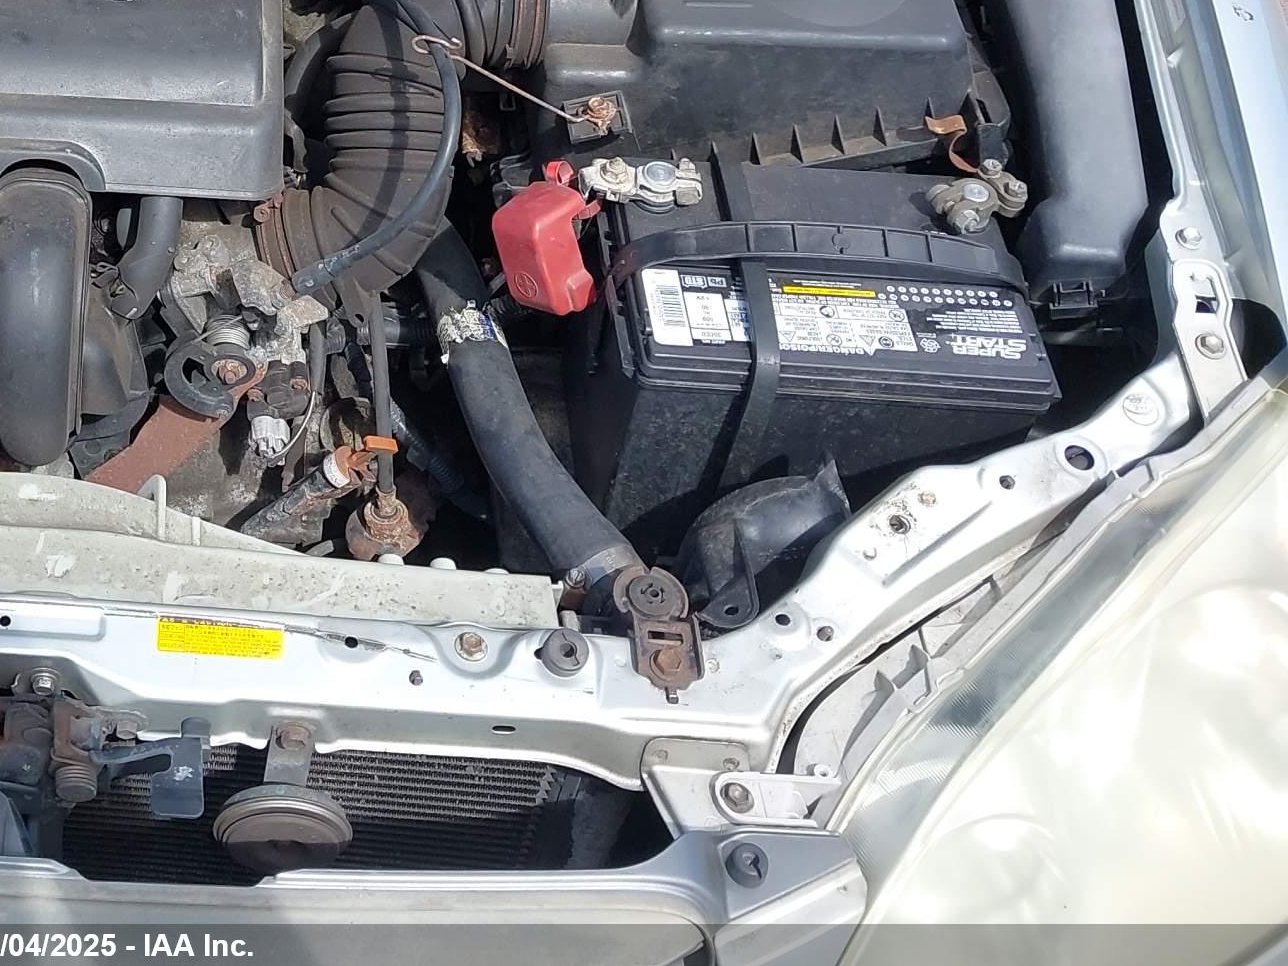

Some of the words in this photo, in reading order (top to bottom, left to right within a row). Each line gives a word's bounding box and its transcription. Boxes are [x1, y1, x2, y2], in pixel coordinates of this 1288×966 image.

[779, 343, 865, 355] DANGER/POISO
[951, 334, 1027, 352] START
[952, 345, 1022, 360] SUPER
